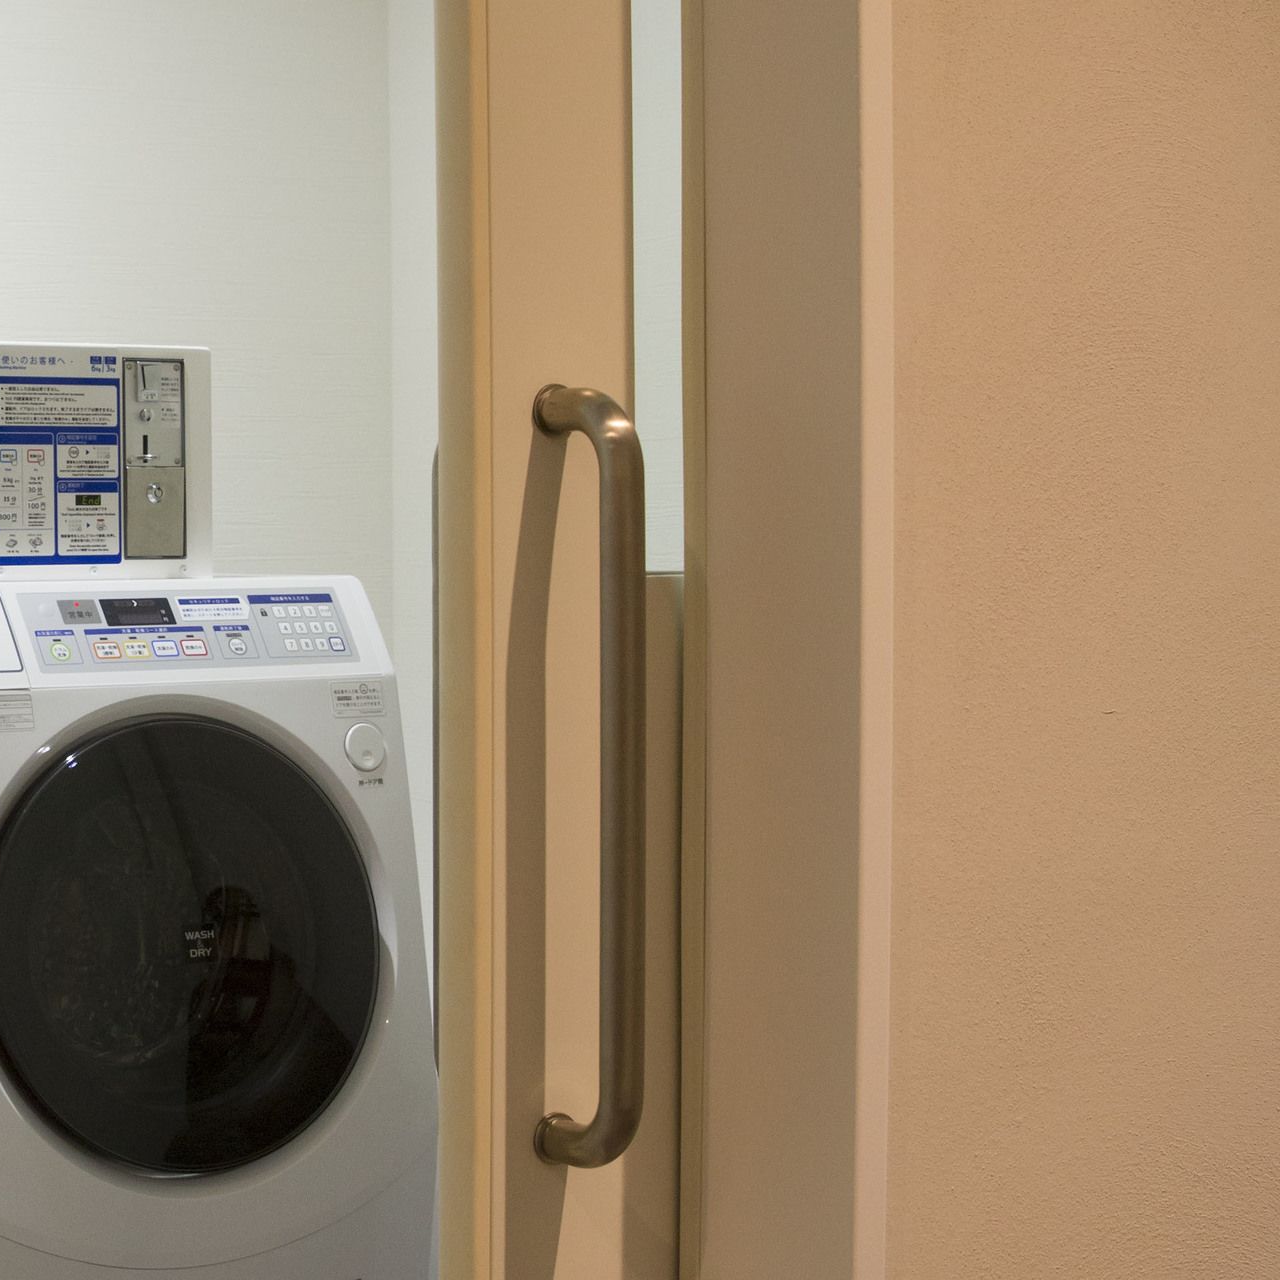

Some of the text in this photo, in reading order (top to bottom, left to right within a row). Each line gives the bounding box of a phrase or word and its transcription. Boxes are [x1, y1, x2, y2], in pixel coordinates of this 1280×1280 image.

[82, 496, 100, 505] End
[185, 930, 215, 940] WASH
[190, 948, 212, 958] DRY
